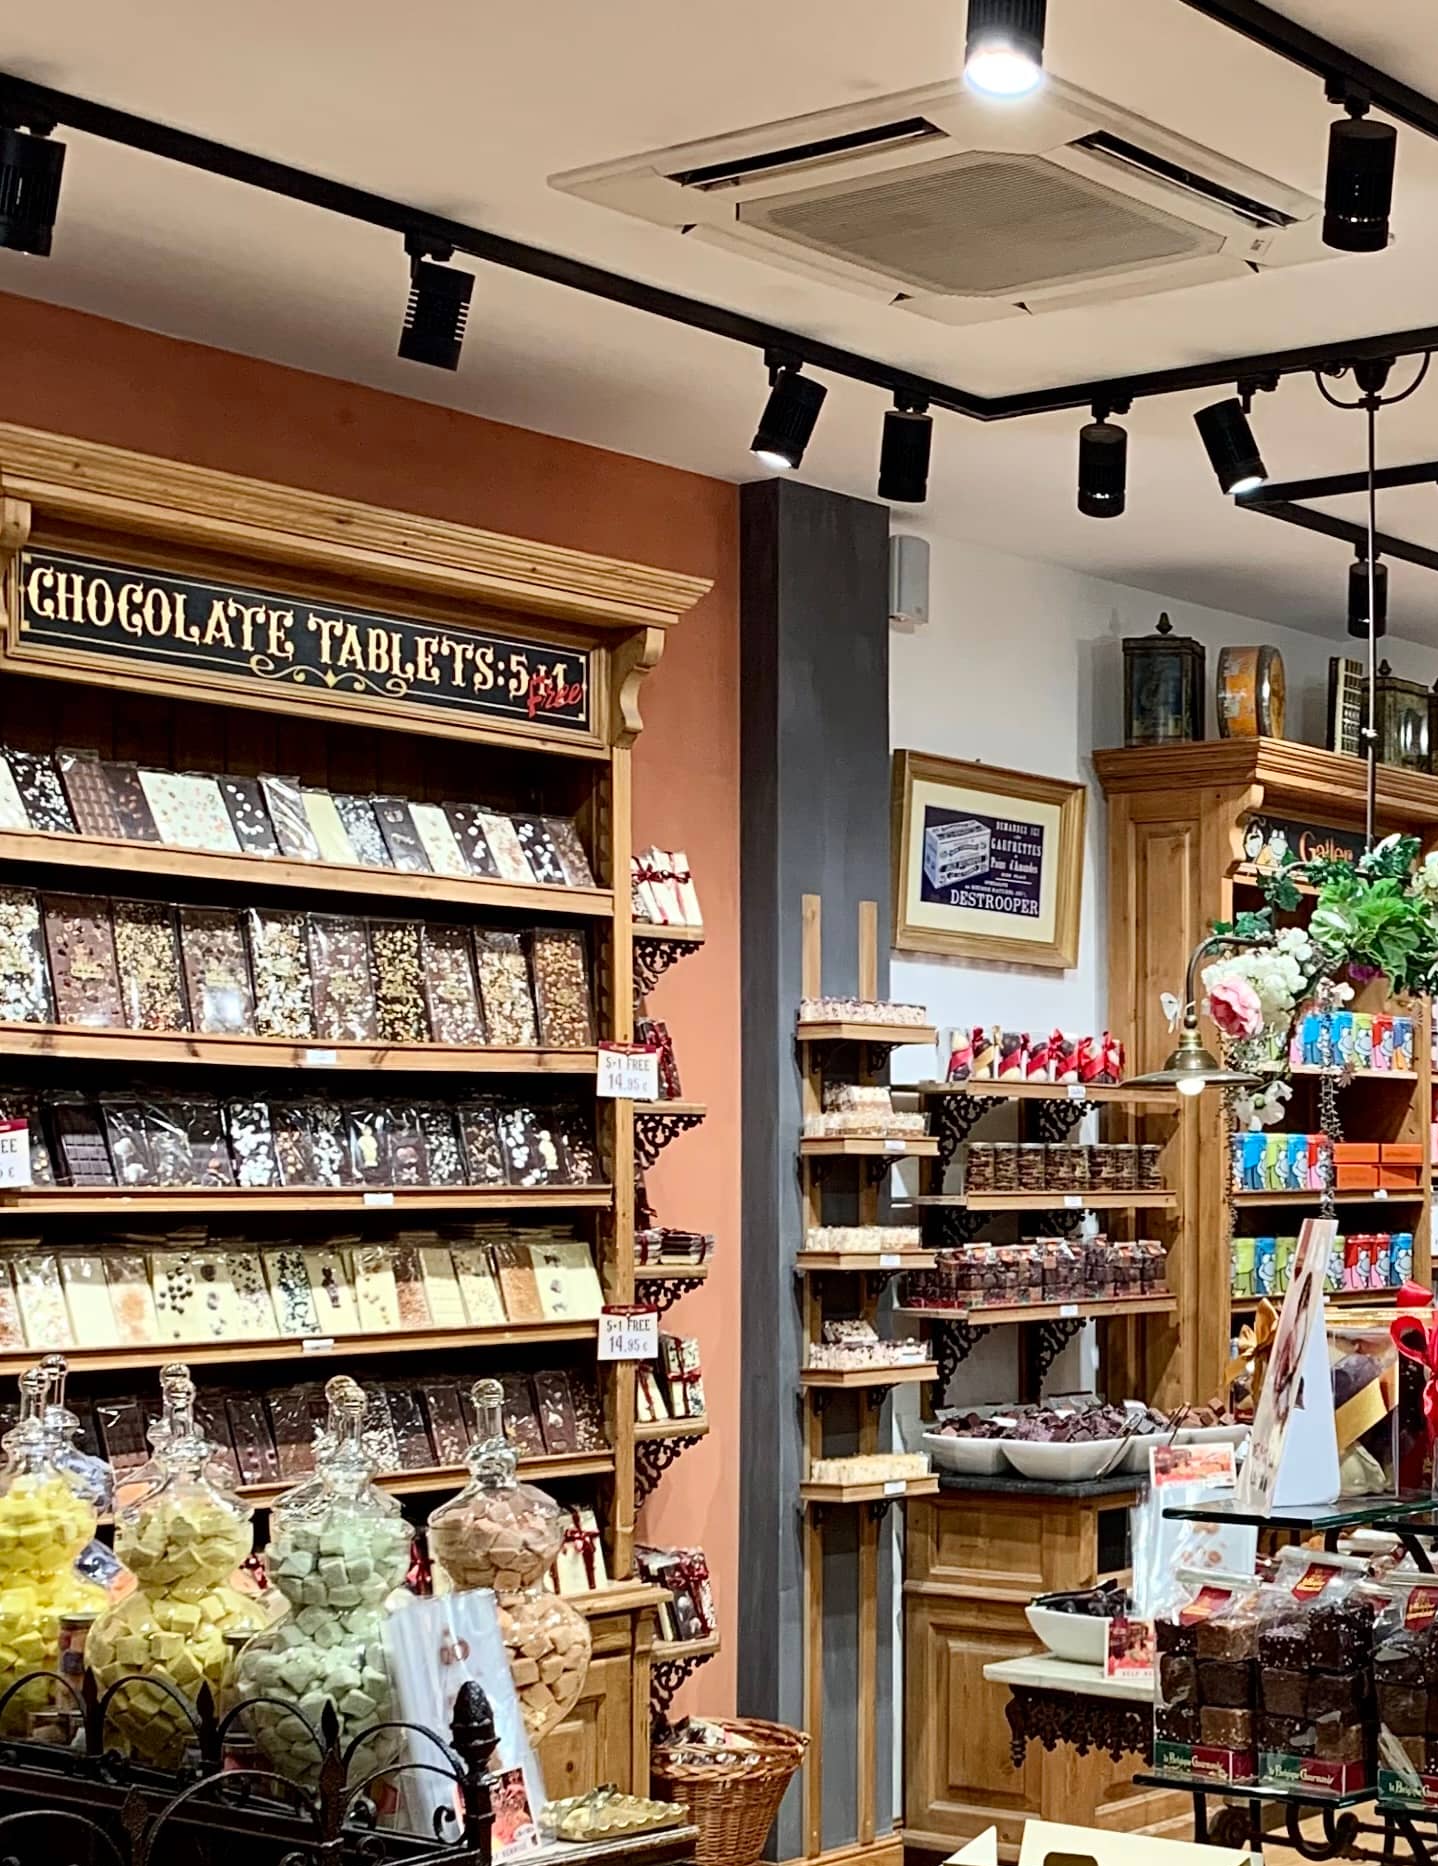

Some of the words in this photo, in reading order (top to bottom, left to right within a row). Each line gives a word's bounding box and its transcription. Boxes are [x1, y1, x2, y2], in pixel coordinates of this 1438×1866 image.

[27, 566, 294, 661] CHOCOLATE
[950, 889, 1039, 914] DESTROOPER
[626, 1058, 650, 1072] FREE
[1, 1138, 18, 1153] EE
[627, 1319, 650, 1332] FREE
